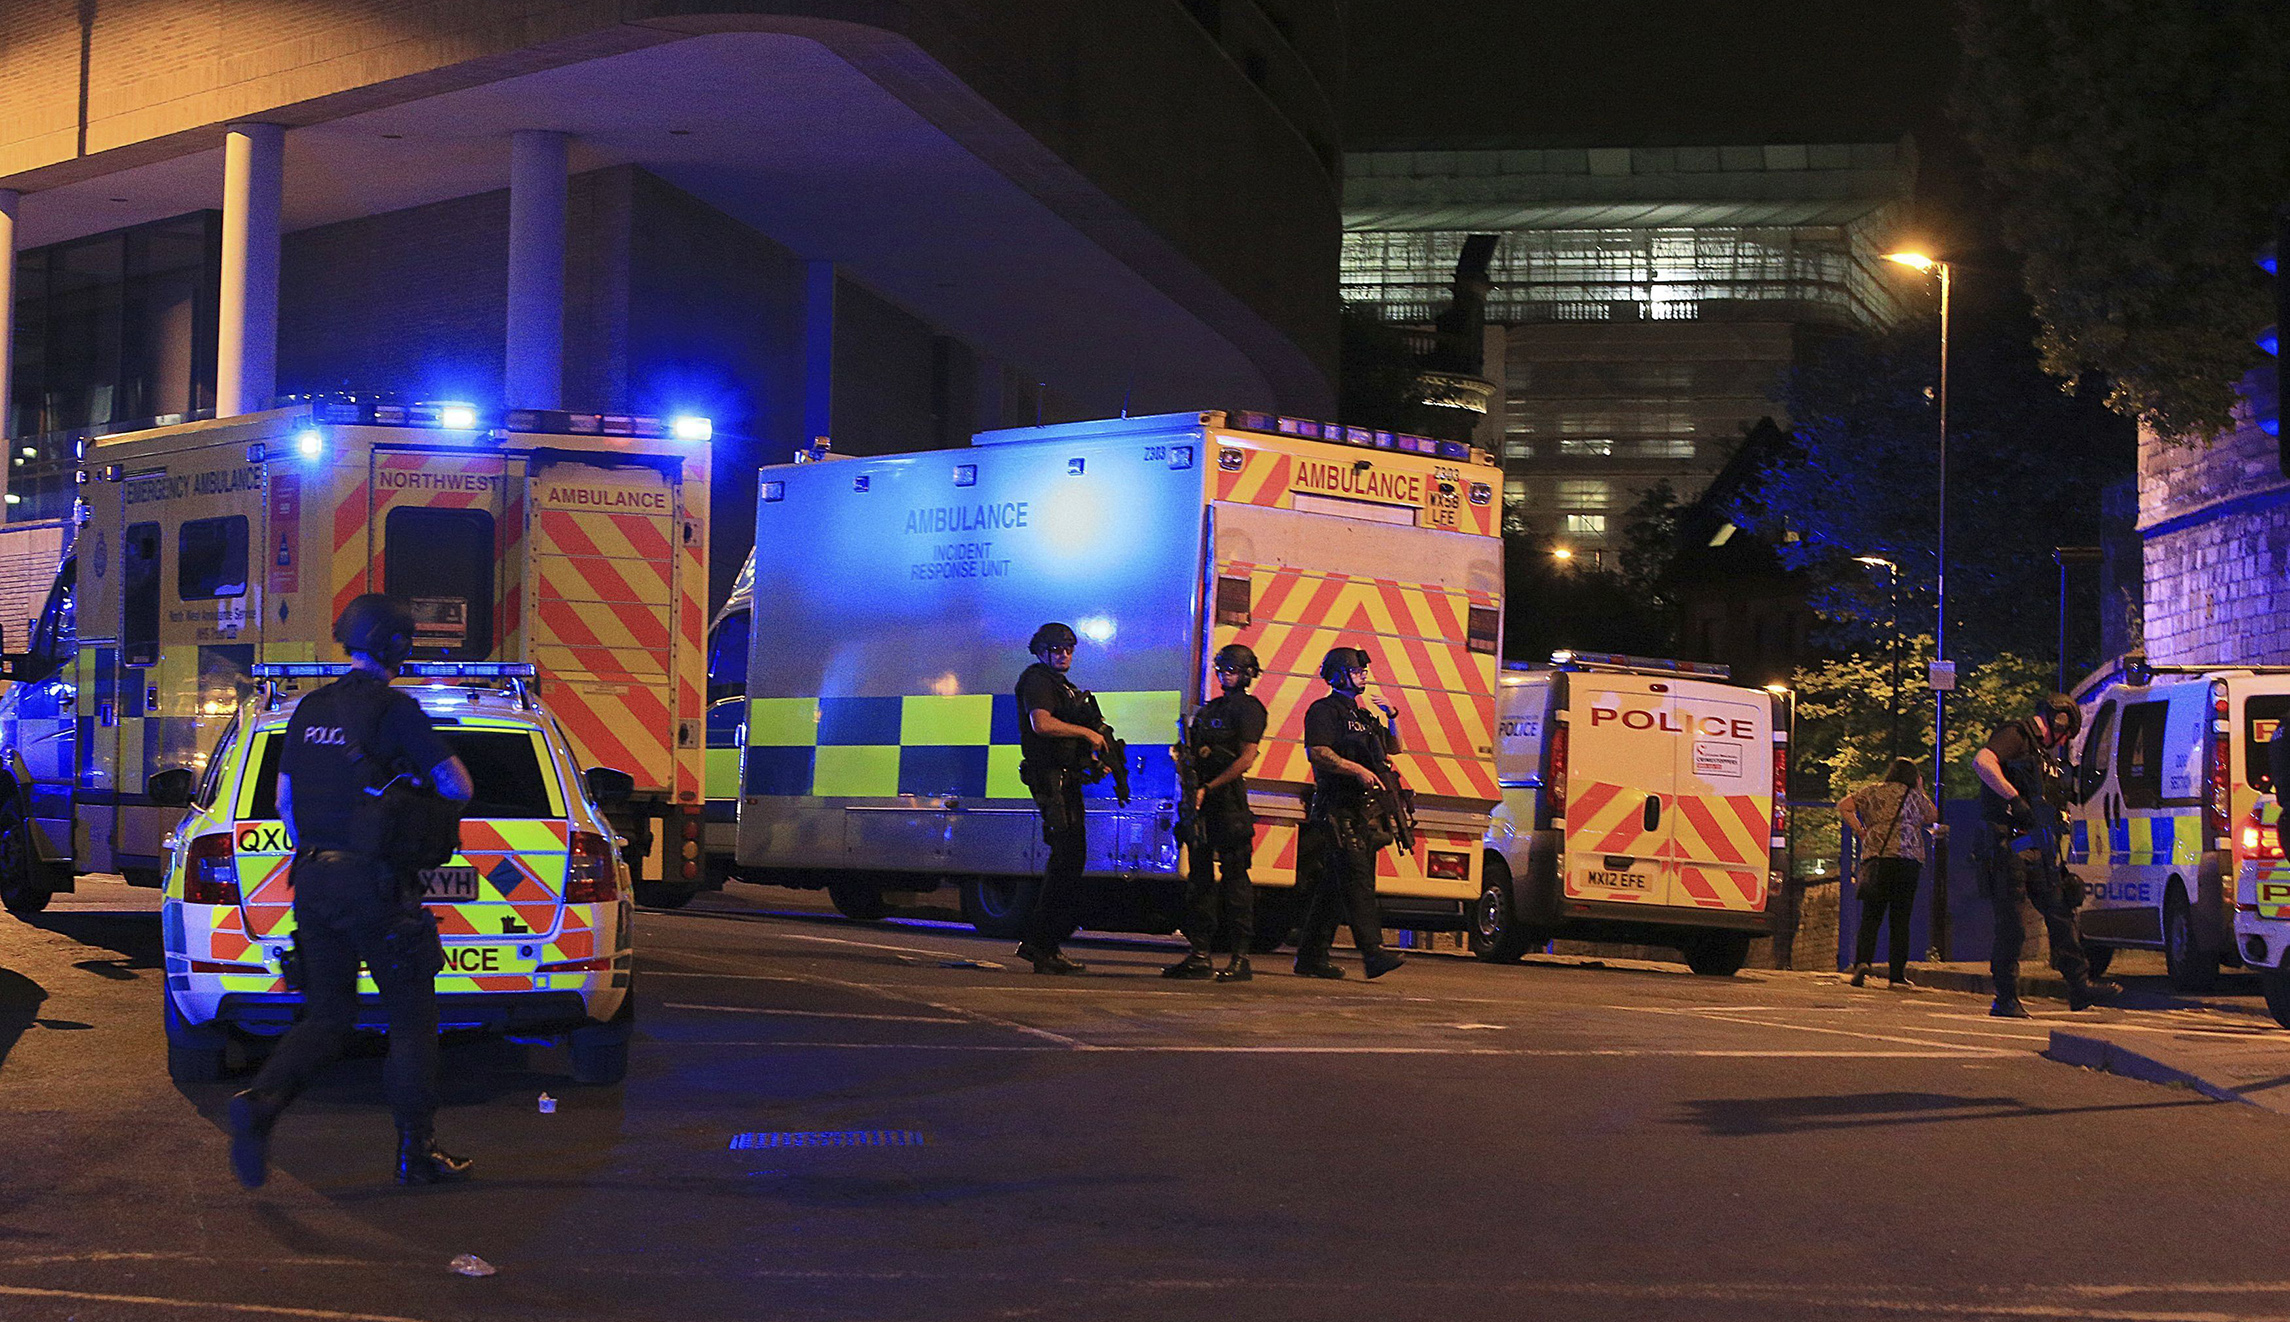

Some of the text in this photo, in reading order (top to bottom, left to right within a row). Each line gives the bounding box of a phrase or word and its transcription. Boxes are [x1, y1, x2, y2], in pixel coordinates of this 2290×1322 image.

[127, 466, 261, 504] EMERGENCY AMBULANCE
[1296, 461, 1420, 502] AMBULANCE
[548, 487, 666, 508] AMBULANCE
[904, 502, 1029, 535] AMBULANCE
[1432, 508, 1455, 526] LFE
[933, 542, 994, 561] INCIDENT
[910, 559, 1012, 581] RESPONSE UNIT
[1498, 721, 1539, 737] POLICE
[1591, 707, 1755, 740] POLICE
[1588, 871, 1646, 889] MX12 EFE
[2084, 882, 2151, 902] POLICE
